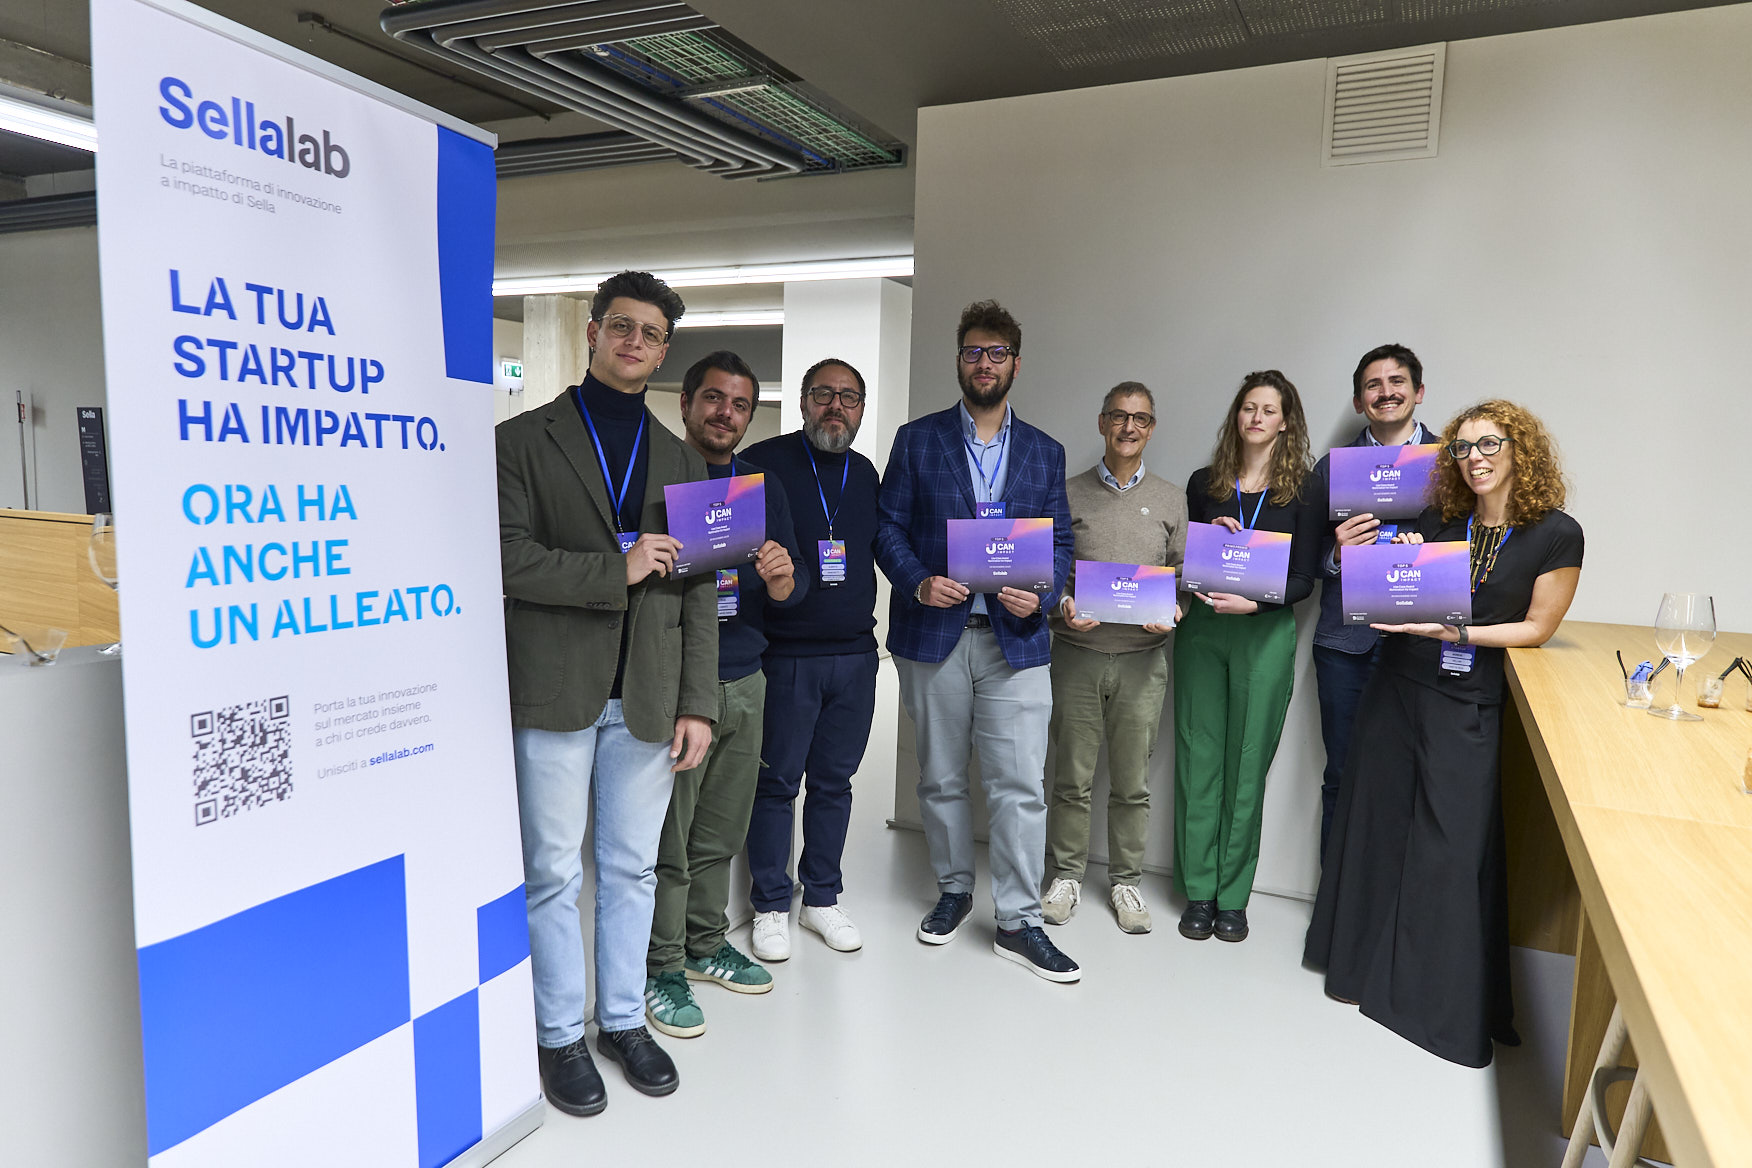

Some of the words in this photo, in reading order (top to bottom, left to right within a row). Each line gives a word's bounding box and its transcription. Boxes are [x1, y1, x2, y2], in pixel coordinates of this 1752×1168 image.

[159, 76, 351, 179] Sellalab
[159, 153, 178, 170] La
[181, 160, 262, 194] piattaforma
[263, 180, 275, 196] di
[276, 184, 343, 215] innovazione
[160, 177, 170, 188] a
[173, 178, 229, 203] impatto
[232, 190, 244, 205] di
[246, 194, 277, 214] Sella
[169, 268, 238, 321] LA
[245, 282, 337, 337] TUA
[173, 334, 385, 395] STARTUP
[82, 410, 96, 419] Sella
[177, 398, 251, 444] HA
[261, 404, 446, 452] IMPATTO.
[1382, 470, 1401, 478] CAN
[181, 483, 287, 526] ORA
[296, 483, 359, 523] HA
[716, 507, 732, 518] CAN
[184, 538, 352, 589] ANCHE
[997, 543, 1015, 551] CAN
[1233, 550, 1250, 559] CAN
[1400, 569, 1421, 578] CAN
[188, 602, 260, 650] UN
[271, 583, 462, 639] ALLEATO.
[314, 700, 345, 715] Porta
[347, 696, 357, 708] la
[358, 694, 376, 706] tua
[377, 682, 438, 702] innovazione
[314, 717, 332, 732] sul
[333, 710, 379, 727] mercato
[381, 702, 422, 718] insieme
[315, 738, 324, 748] a
[325, 732, 342, 745] chi
[344, 729, 354, 741] ci
[356, 725, 387, 741] crede
[388, 714, 433, 735] davvero.
[317, 759, 359, 780] Unisciti
[359, 758, 368, 769] a
[369, 741, 435, 768] sellalab.com
